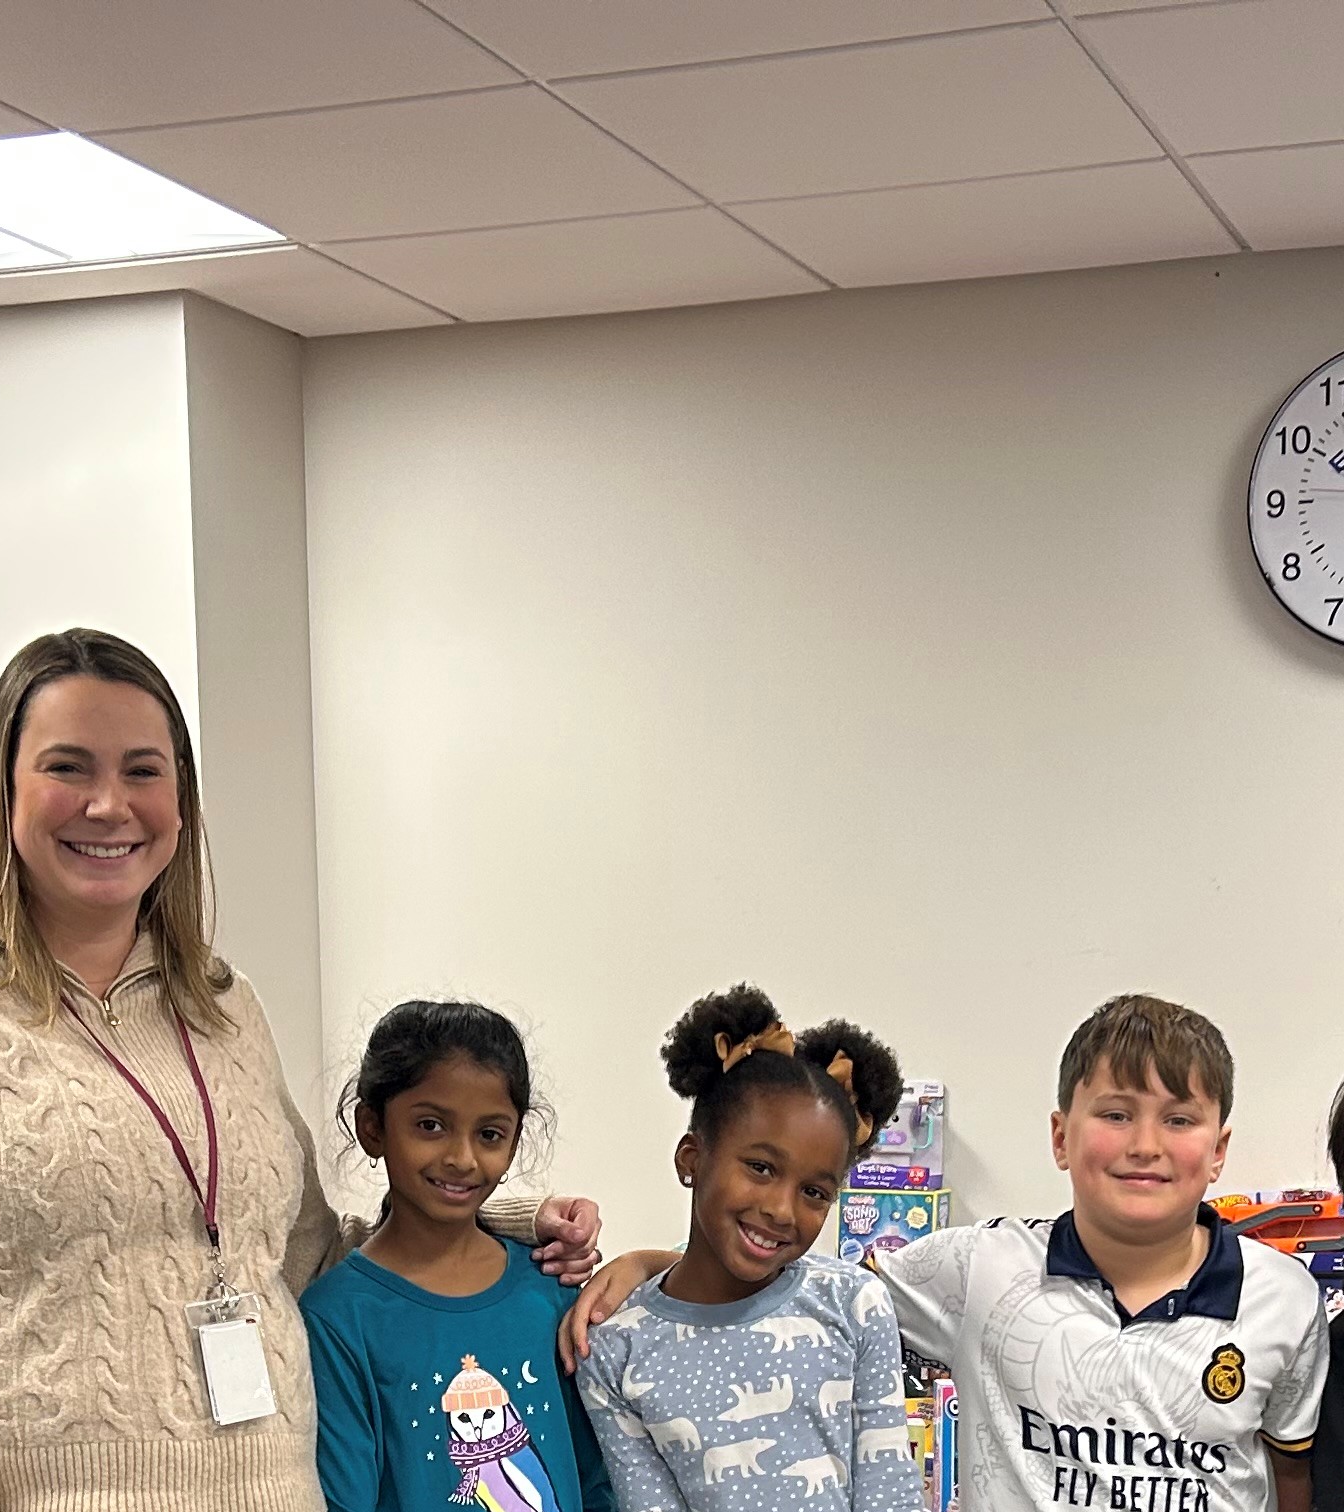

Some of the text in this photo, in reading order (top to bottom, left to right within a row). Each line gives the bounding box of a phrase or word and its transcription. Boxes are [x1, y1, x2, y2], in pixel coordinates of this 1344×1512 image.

[1275, 426, 1311, 456] 10
[1266, 490, 1286, 519] 9
[1281, 552, 1302, 582] 8
[1324, 598, 1344, 627] 7
[845, 1206, 881, 1221] SAND
[1017, 1403, 1232, 1474] Emirates
[1052, 1466, 1098, 1508] FLY
